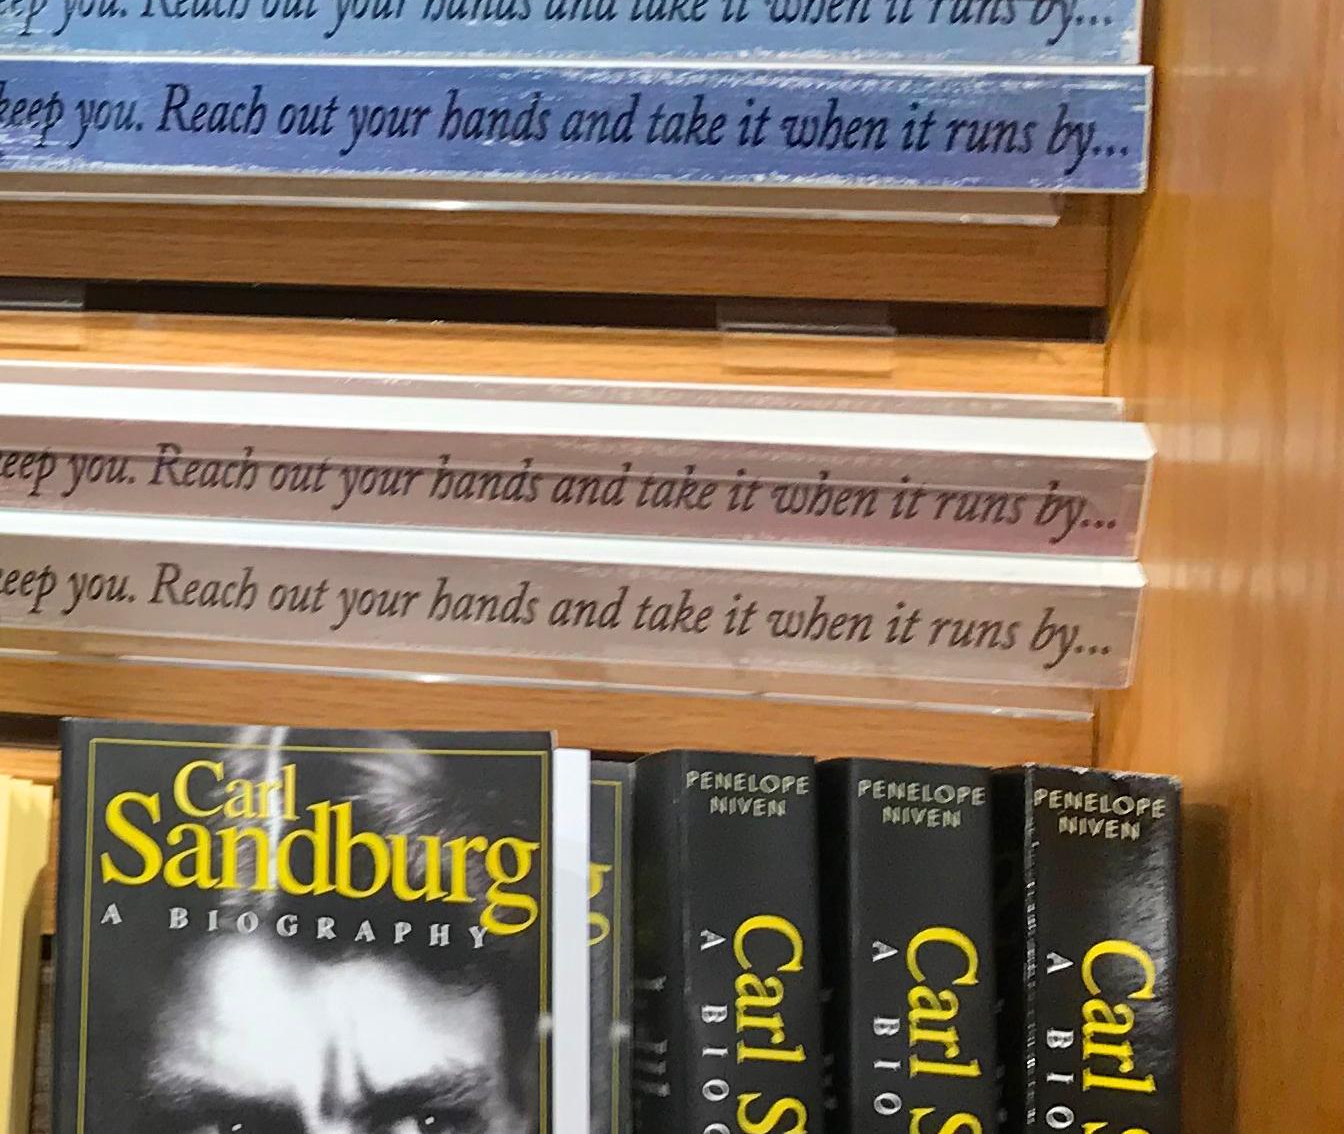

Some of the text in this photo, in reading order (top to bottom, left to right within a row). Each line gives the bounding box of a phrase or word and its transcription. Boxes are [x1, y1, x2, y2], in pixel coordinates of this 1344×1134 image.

[72, 98, 143, 150] you.
[158, 83, 265, 135] Reach
[279, 97, 336, 136] out
[339, 104, 431, 156] your
[439, 89, 552, 142] hands
[560, 95, 641, 144] and
[648, 97, 725, 147] take
[740, 99, 771, 145] it
[781, 98, 888, 150] when
[902, 103, 935, 151] it
[943, 116, 1034, 156] runs
[61, 569, 136, 616] you.
[149, 563, 256, 609] Reach
[269, 579, 326, 614] out
[330, 585, 418, 631] your
[427, 577, 537, 626] hands
[549, 586, 624, 630] and
[633, 591, 714, 634] take
[724, 594, 758, 636] it
[767, 596, 872, 642] when
[886, 601, 922, 645] it
[929, 616, 1021, 650] runs
[173, 759, 299, 822] Carl
[686, 771, 810, 795] PENELOPE
[710, 795, 786, 818] NIVEN
[858, 779, 986, 807] PENELOPE
[1033, 788, 1167, 821] PENELOPE
[882, 805, 962, 829] NIVEN
[1057, 814, 1141, 841] NIVEN
[100, 791, 539, 936] Sandburg
[100, 904, 488, 949] A BIOGRAPHY
[733, 914, 807, 1064] Carl
[906, 927, 982, 1079] Carl
[1081, 939, 1157, 1094] Carl
